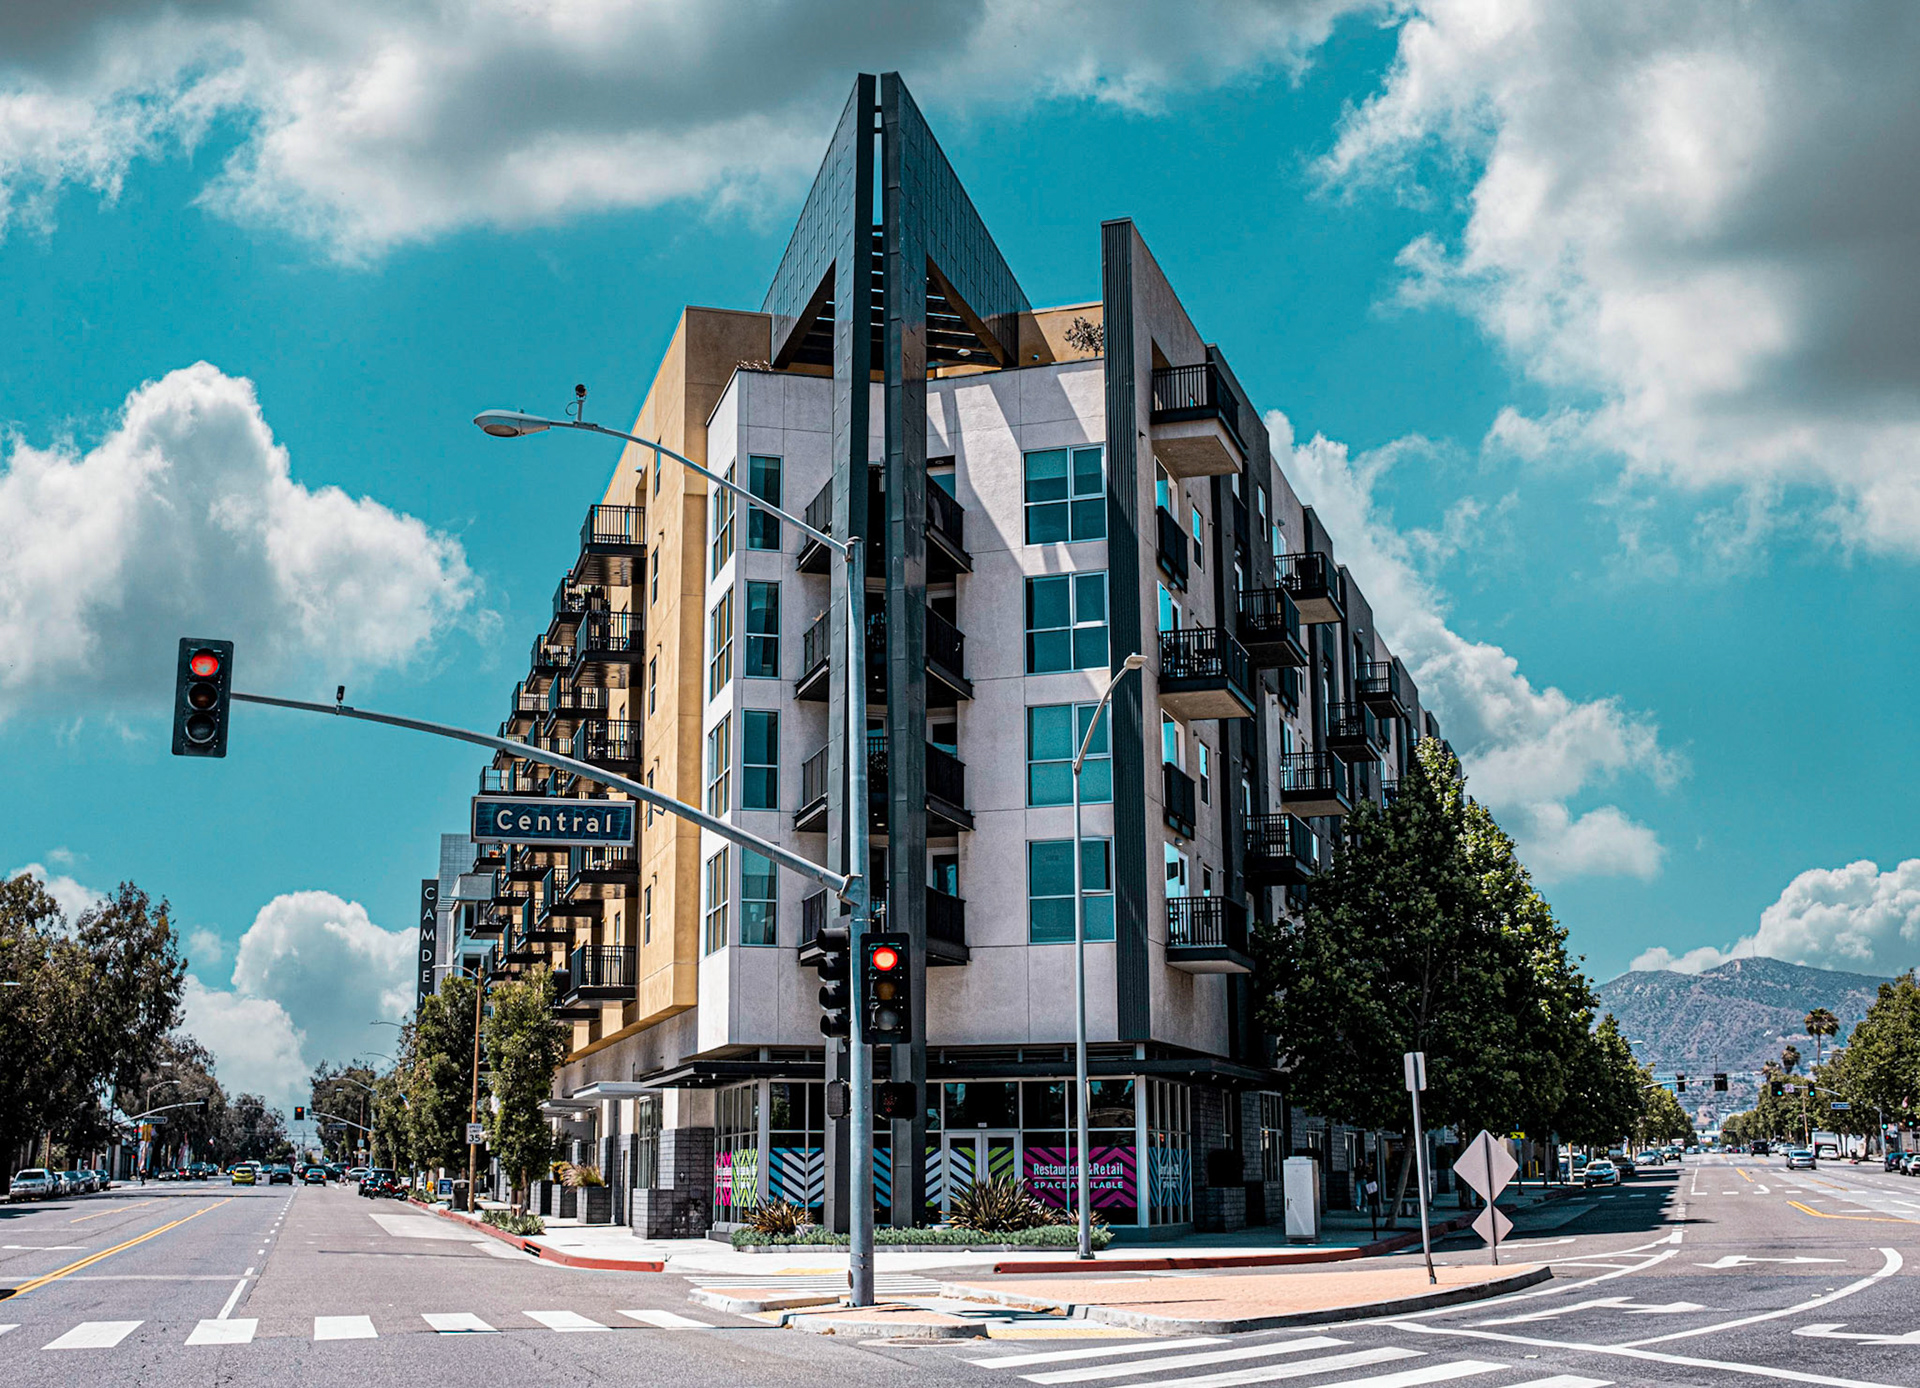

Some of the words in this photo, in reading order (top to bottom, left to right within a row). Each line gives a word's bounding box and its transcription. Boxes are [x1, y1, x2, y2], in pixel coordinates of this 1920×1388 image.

[497, 809, 611, 833] Central
[469, 1134, 481, 1143] 35
[1070, 1181, 1123, 1189] AILABLE
